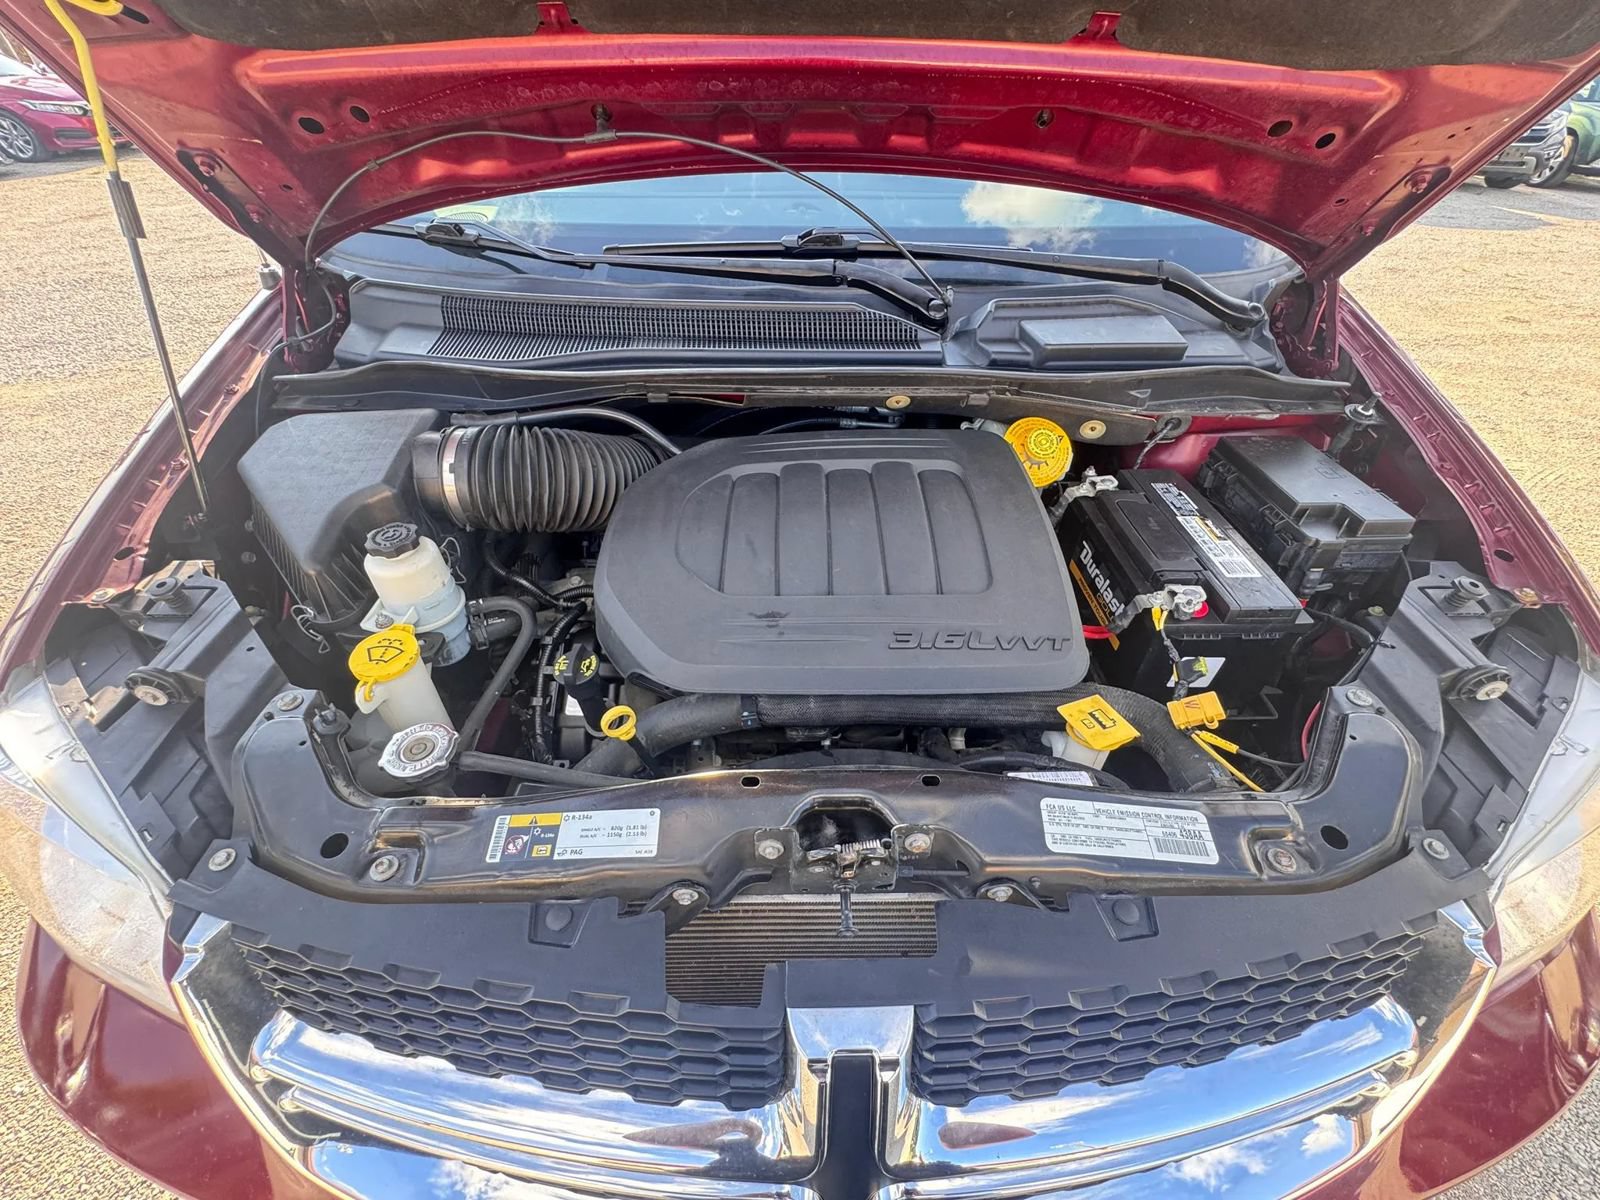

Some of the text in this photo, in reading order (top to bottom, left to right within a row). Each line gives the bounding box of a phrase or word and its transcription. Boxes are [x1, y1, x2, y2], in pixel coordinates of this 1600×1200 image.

[1080, 541, 1126, 618] Duralast
[1116, 809, 1140, 818] EMISSION
[1141, 812, 1163, 820] CONTROL
[1164, 813, 1199, 822] INFORMATION
[1179, 828, 1205, 840] 438AA
